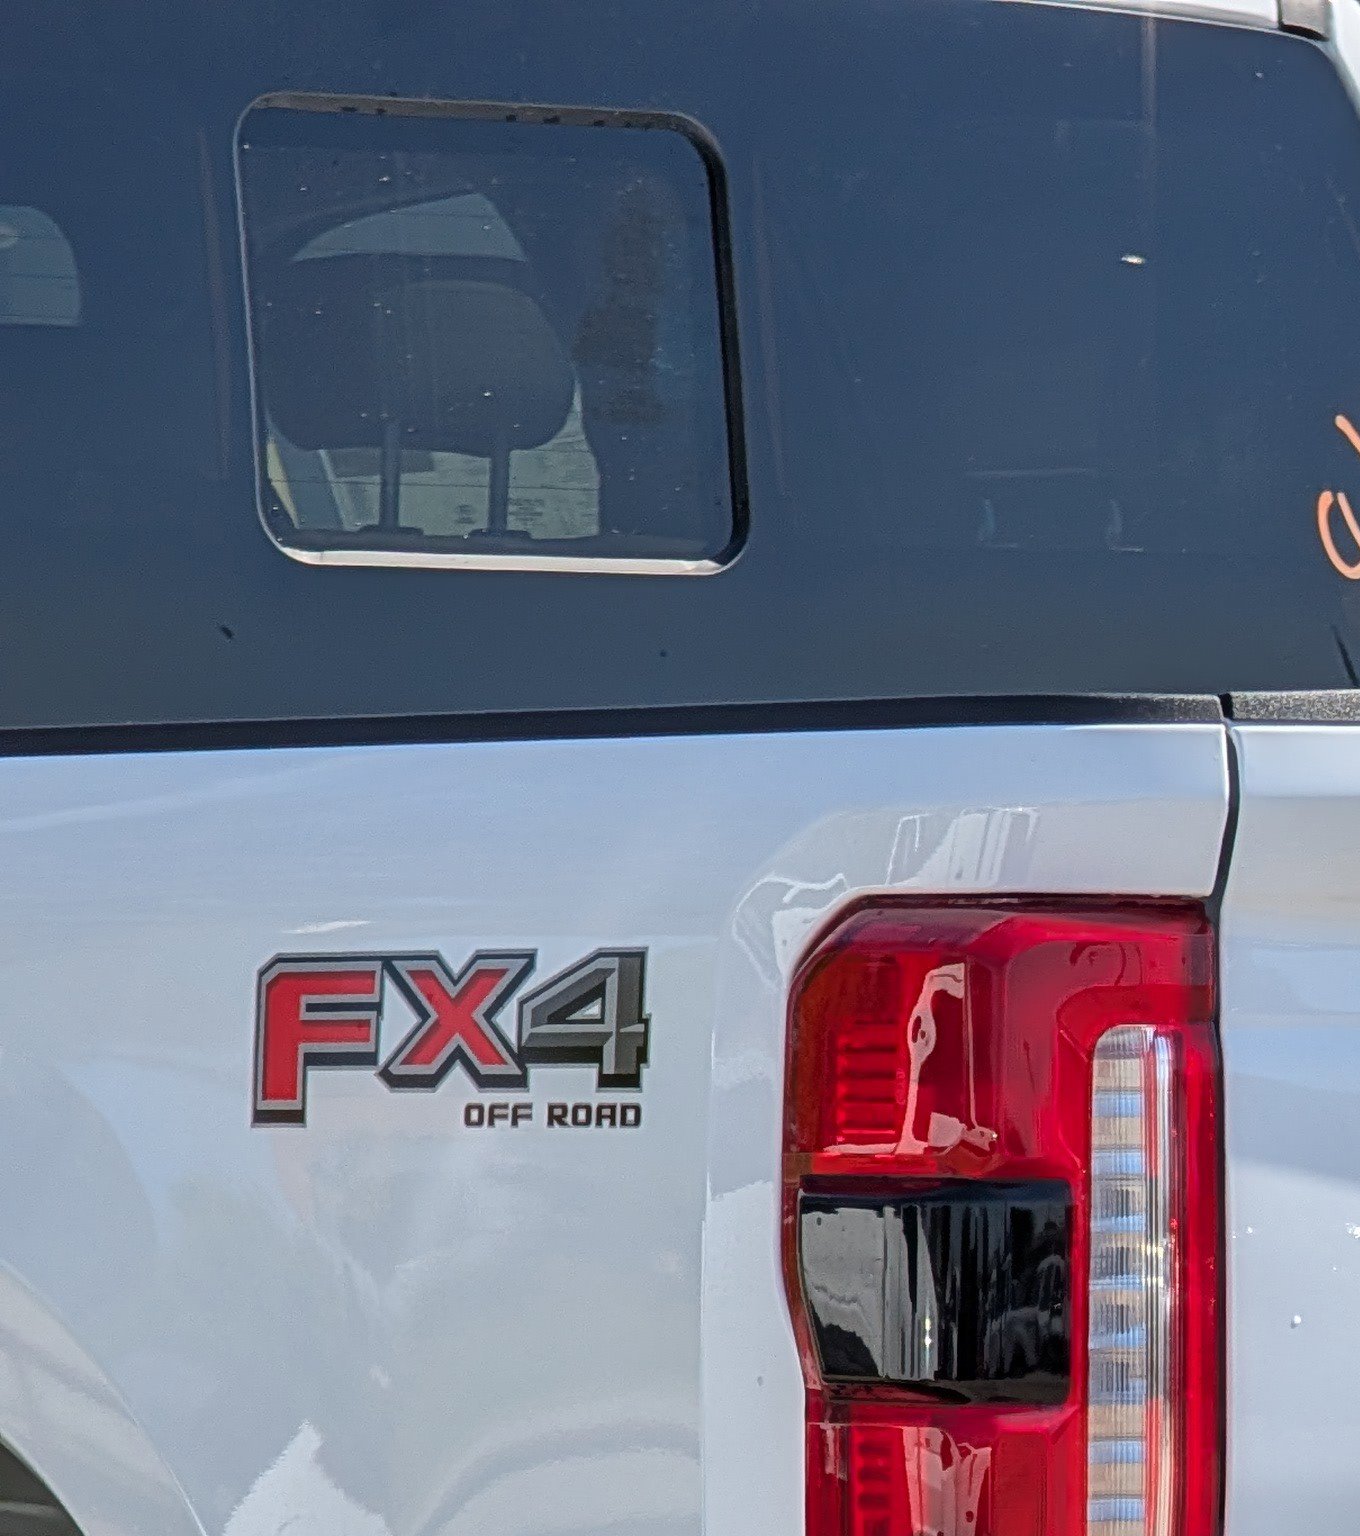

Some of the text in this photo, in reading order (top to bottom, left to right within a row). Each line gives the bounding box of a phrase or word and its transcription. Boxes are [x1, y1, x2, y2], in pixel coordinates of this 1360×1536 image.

[251, 946, 650, 1128] FX4
[463, 1101, 643, 1129] OFF ROAD
